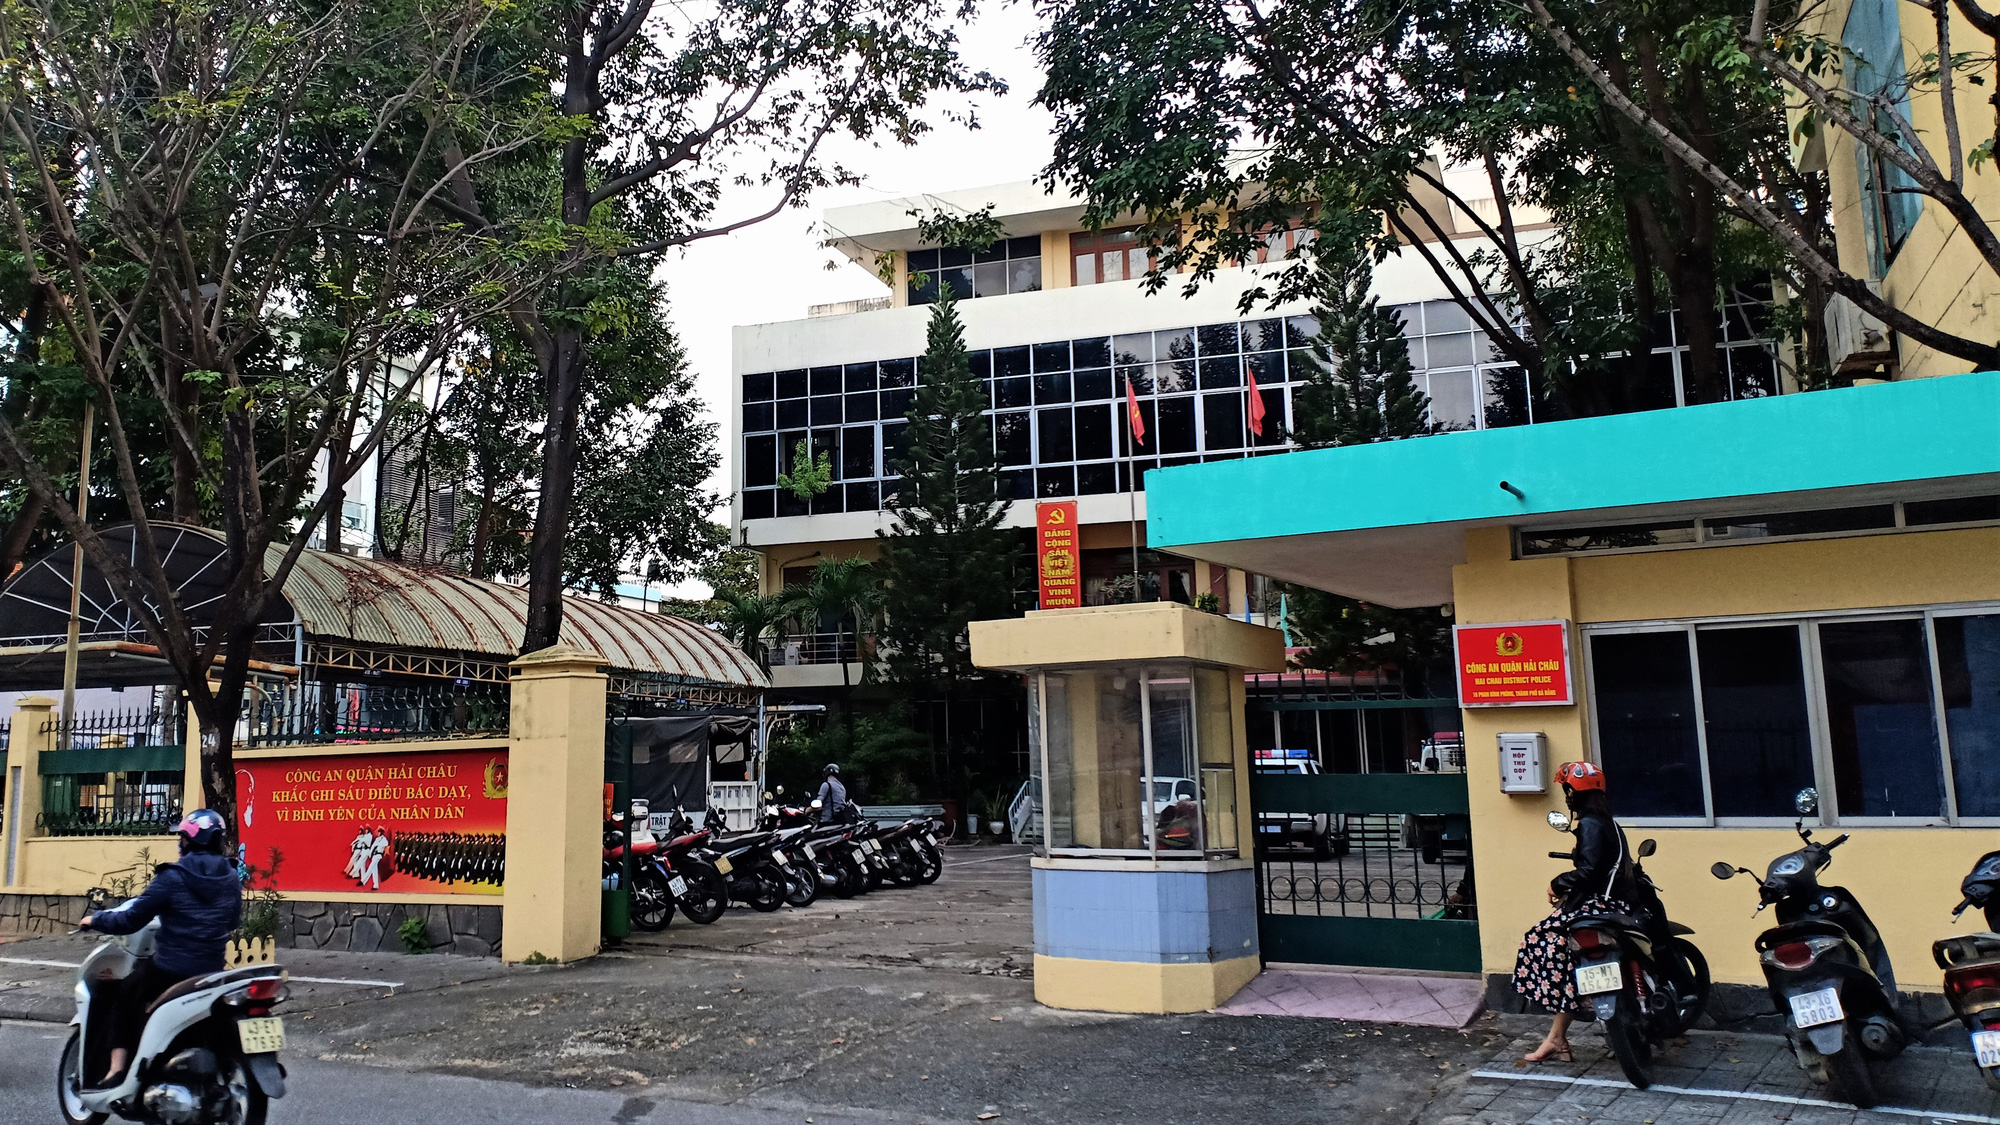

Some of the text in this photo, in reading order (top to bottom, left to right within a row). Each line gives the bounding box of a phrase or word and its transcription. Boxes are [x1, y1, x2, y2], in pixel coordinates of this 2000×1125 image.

[1044, 529, 1071, 538] ĐẢNG
[1045, 539, 1071, 548] CỘNG
[1048, 548, 1069, 556] SẢN
[1049, 559, 1068, 567] VIỆT
[1043, 578, 1076, 586] QUANG
[1048, 588, 1071, 596] VINH
[1046, 596, 1075, 605] MUÔN
[1465, 659, 1559, 674] CÔNG AN QUẬN HẢI CHÂU
[1486, 677, 1502, 685] CHAU
[1503, 676, 1529, 684] DISTRICT
[202, 733, 216, 748] 24
[285, 763, 458, 783] CÔNG AN QUẬN HẢI CHÂU
[271, 782, 471, 803] KHẮC GHI SÁU ĐIỀU BÁC DẠY,
[276, 803, 465, 821] VÌ BÌNH YÊN CỦA NHÂN DÂN
[1801, 1006, 1836, 1024] 5803
[1981, 1049, 2000, 1064] 02
